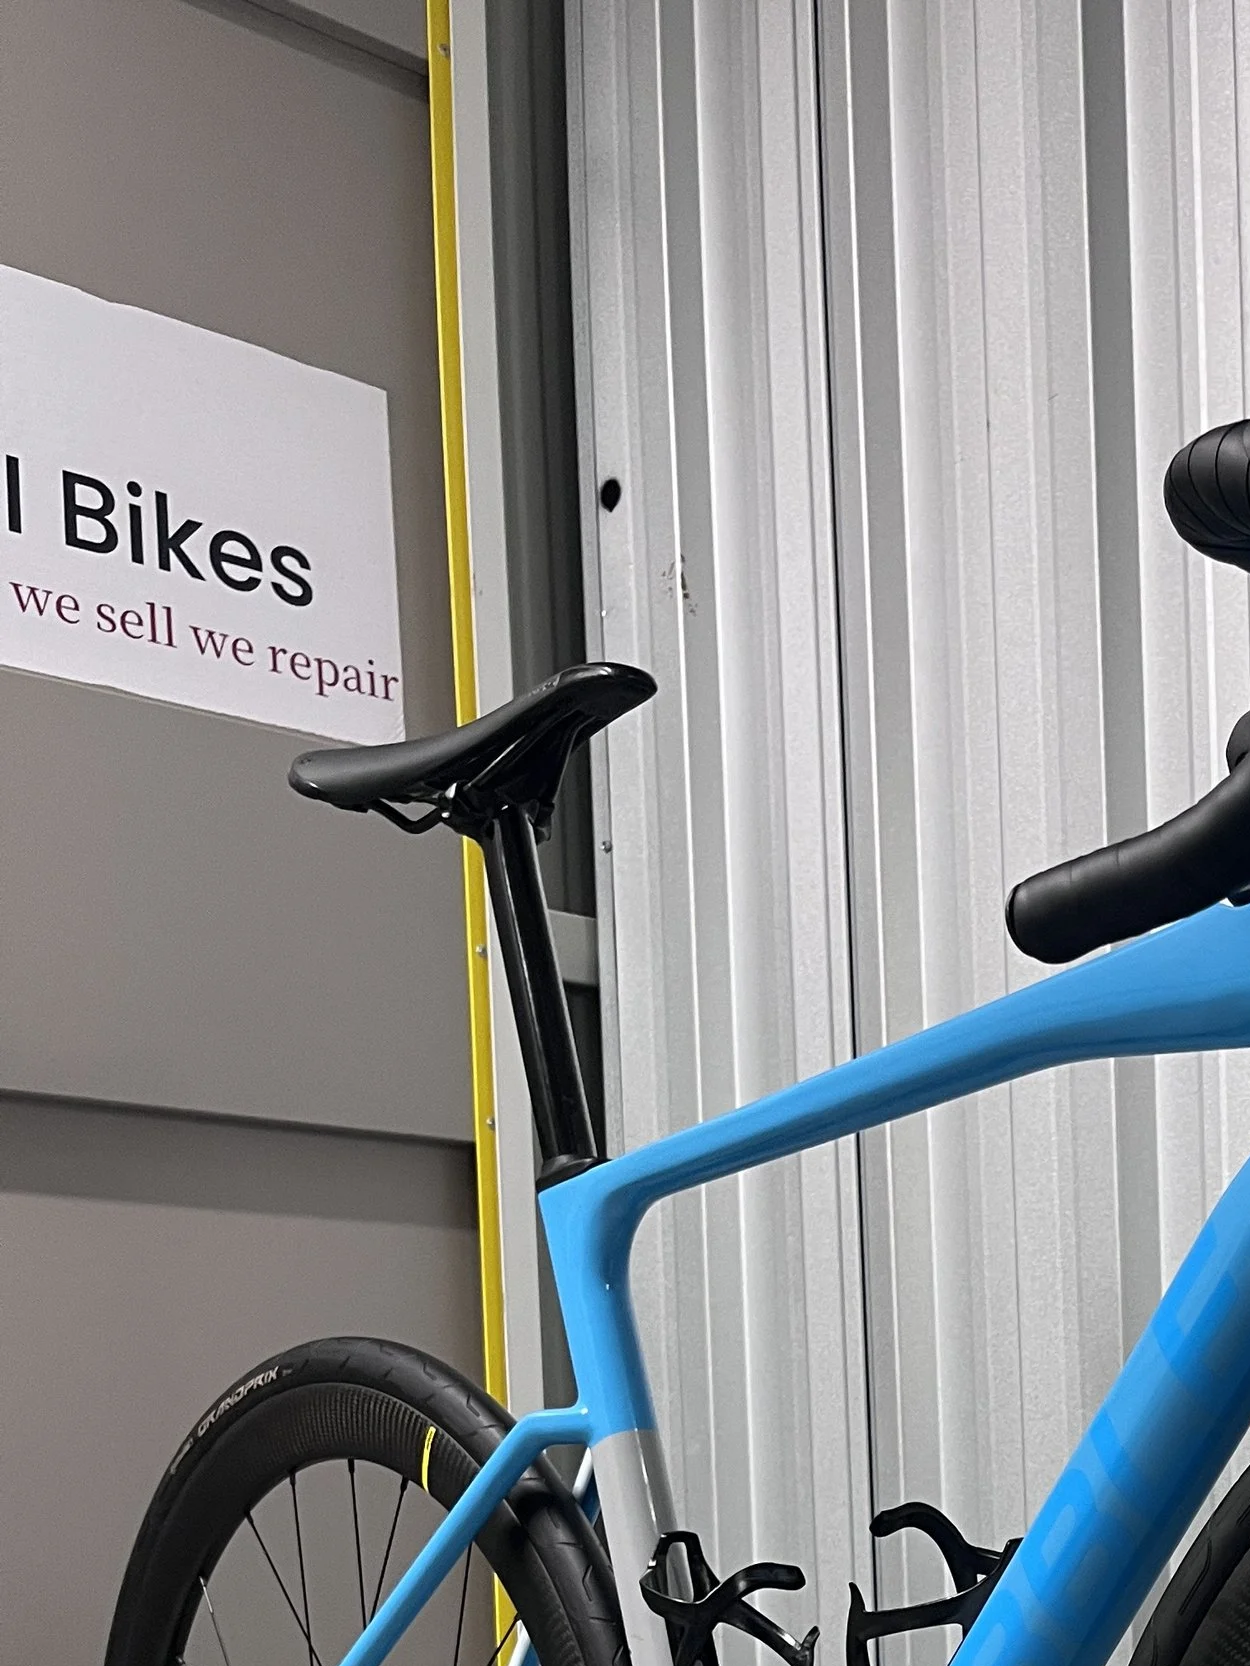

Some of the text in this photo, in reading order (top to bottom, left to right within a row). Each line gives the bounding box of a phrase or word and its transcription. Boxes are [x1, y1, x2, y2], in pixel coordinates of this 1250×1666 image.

[62, 469, 314, 607] Bikes
[9, 581, 399, 702] we sell we repair
